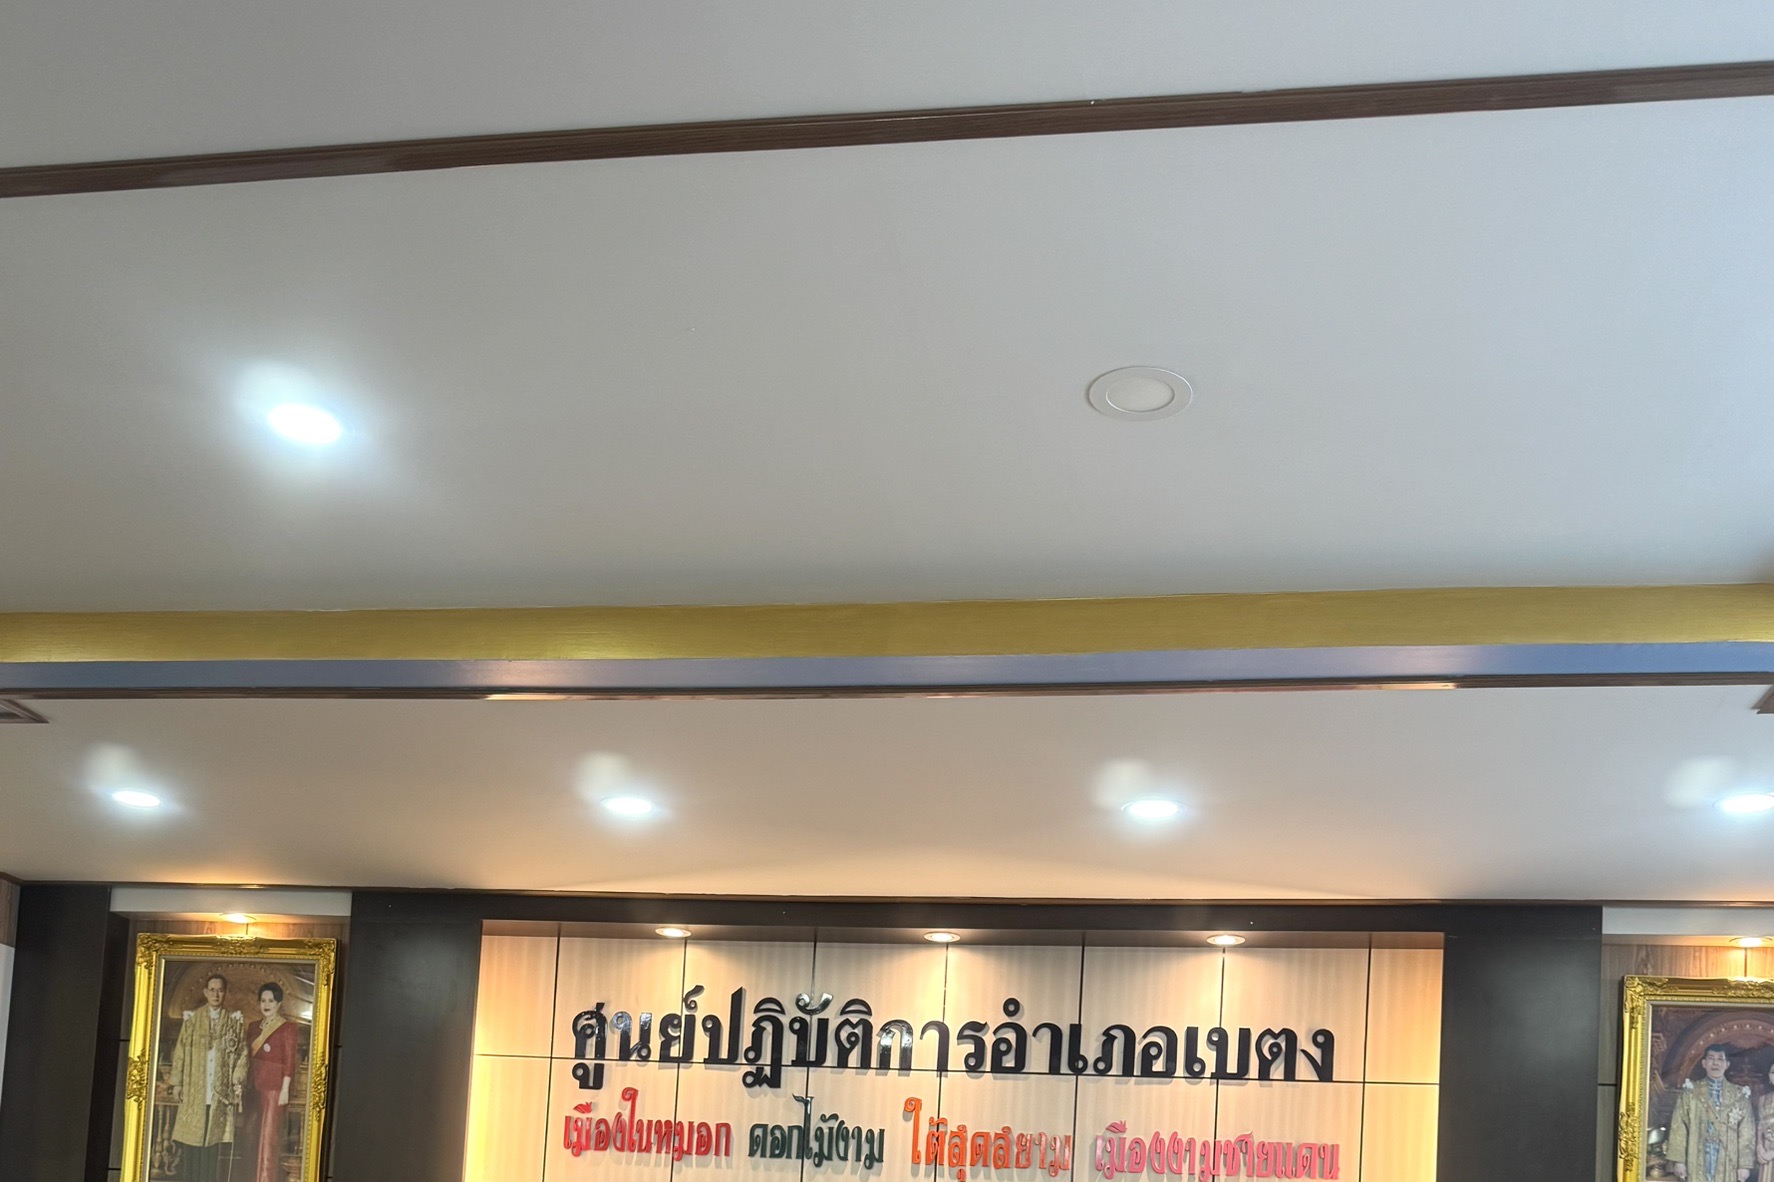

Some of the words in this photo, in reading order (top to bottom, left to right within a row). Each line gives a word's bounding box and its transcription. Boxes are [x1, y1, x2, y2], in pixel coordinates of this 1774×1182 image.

[572, 985, 1335, 1089] ศูนย์ปฏิบัติการอำเภอเบตง
[563, 1087, 732, 1162] เมืองในหมอก
[748, 1093, 885, 1170] ดอกไม้งาม
[904, 1097, 1072, 1182] ใต้สุดสยาม
[1095, 1120, 1340, 1182] เมืองงามชายแดน
